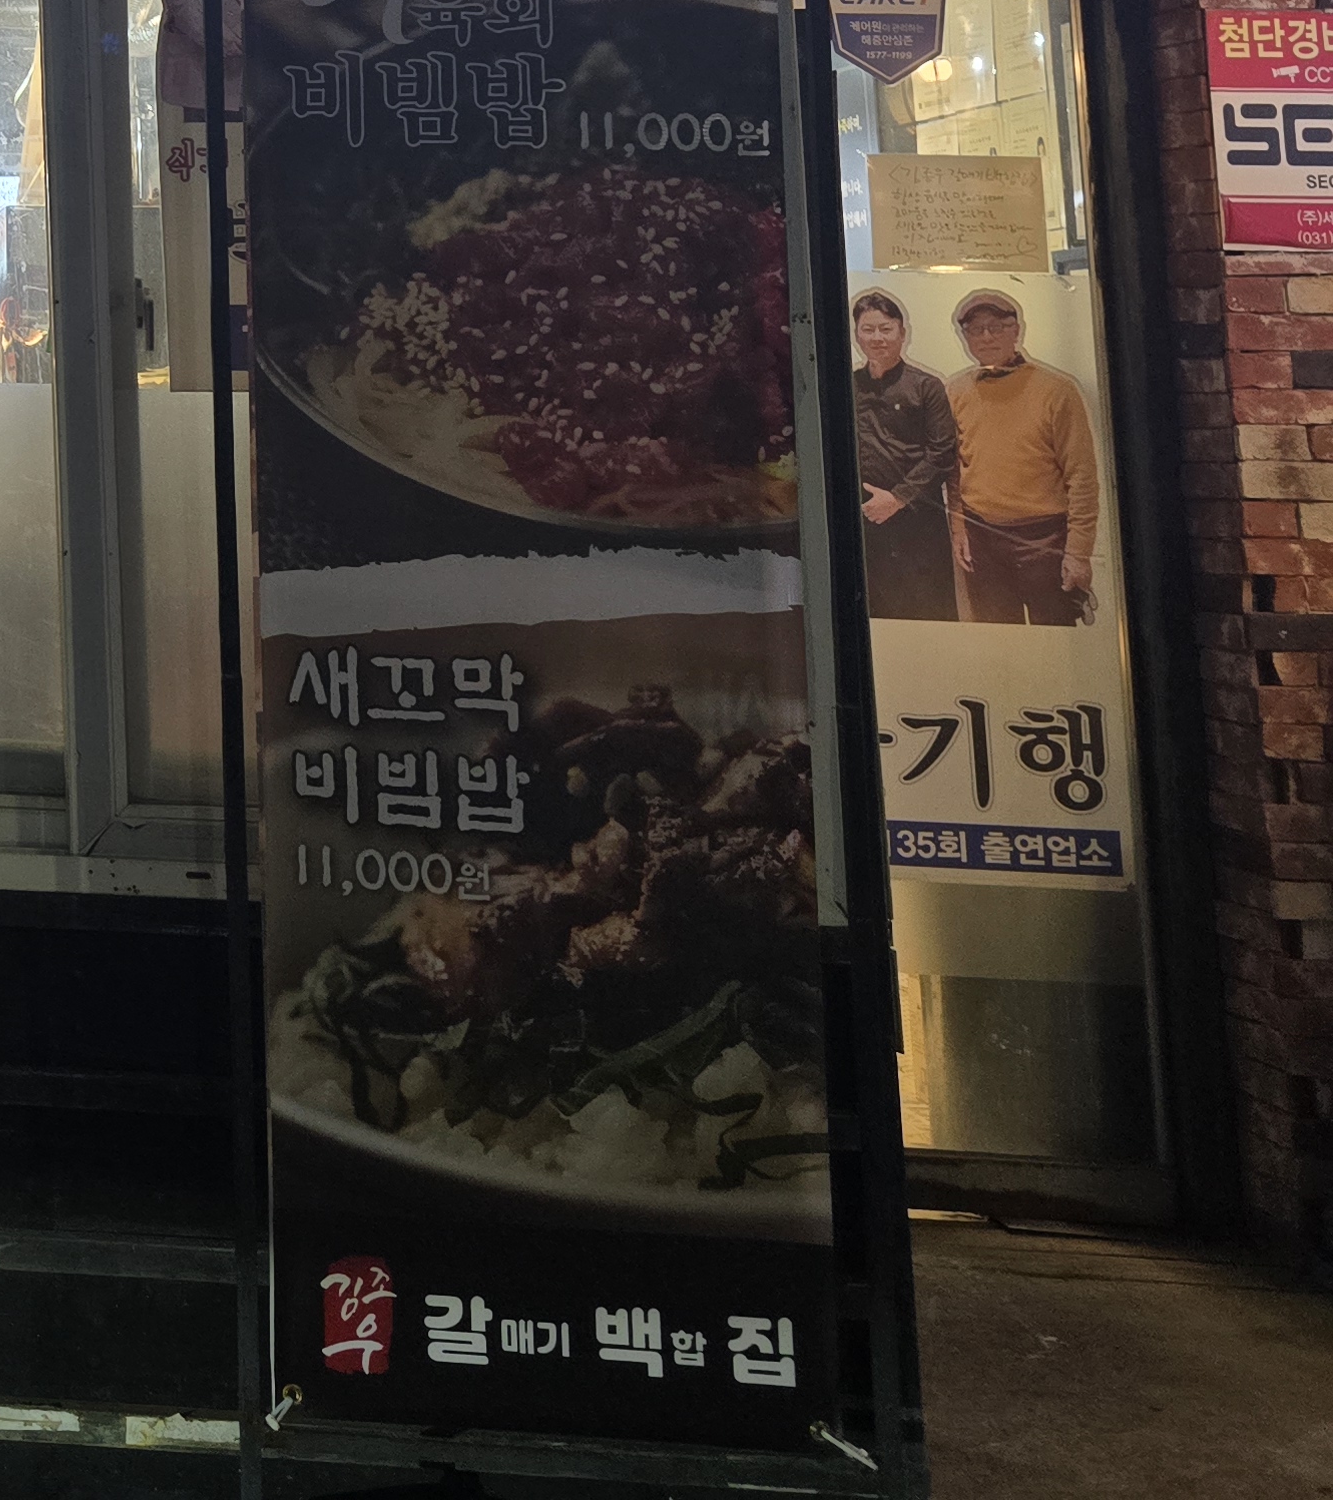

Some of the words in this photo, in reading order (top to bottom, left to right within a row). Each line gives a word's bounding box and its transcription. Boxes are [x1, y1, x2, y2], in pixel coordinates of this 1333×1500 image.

[282, 50, 567, 150] 비빔밥
[578, 111, 772, 158] 11,000원
[165, 137, 209, 182] 식
[288, 645, 525, 732] 새꼬막
[294, 745, 531, 833] 비빔밥
[879, 696, 1109, 815] 기행
[297, 843, 492, 902] 11,000원
[980, 831, 1113, 868] 출연업소
[726, 1314, 797, 1388] 집
